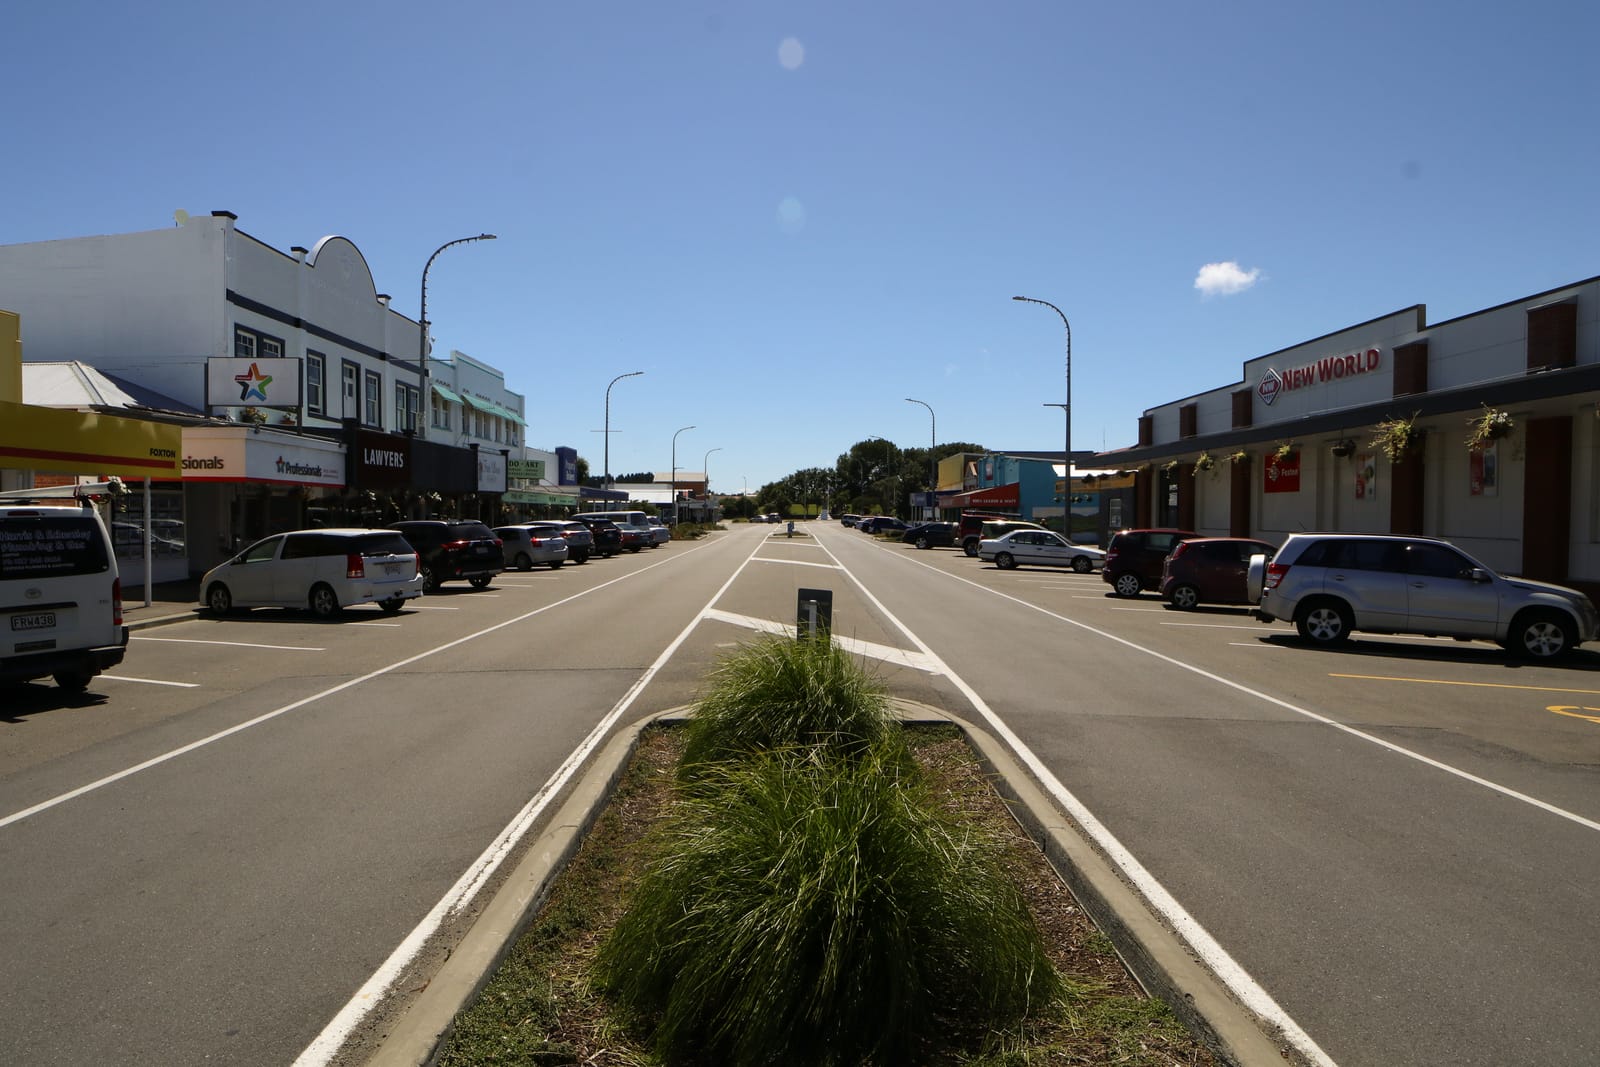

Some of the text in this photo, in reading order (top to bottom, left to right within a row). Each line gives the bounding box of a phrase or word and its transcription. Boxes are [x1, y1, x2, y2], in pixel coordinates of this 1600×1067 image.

[1282, 348, 1381, 392] NEW WORLD
[149, 448, 176, 458] FOXTON
[364, 447, 404, 468] LAWYERS
[182, 456, 224, 469] sionals
[286, 461, 322, 477] Professionals
[13, 615, 54, 628] FRW438
